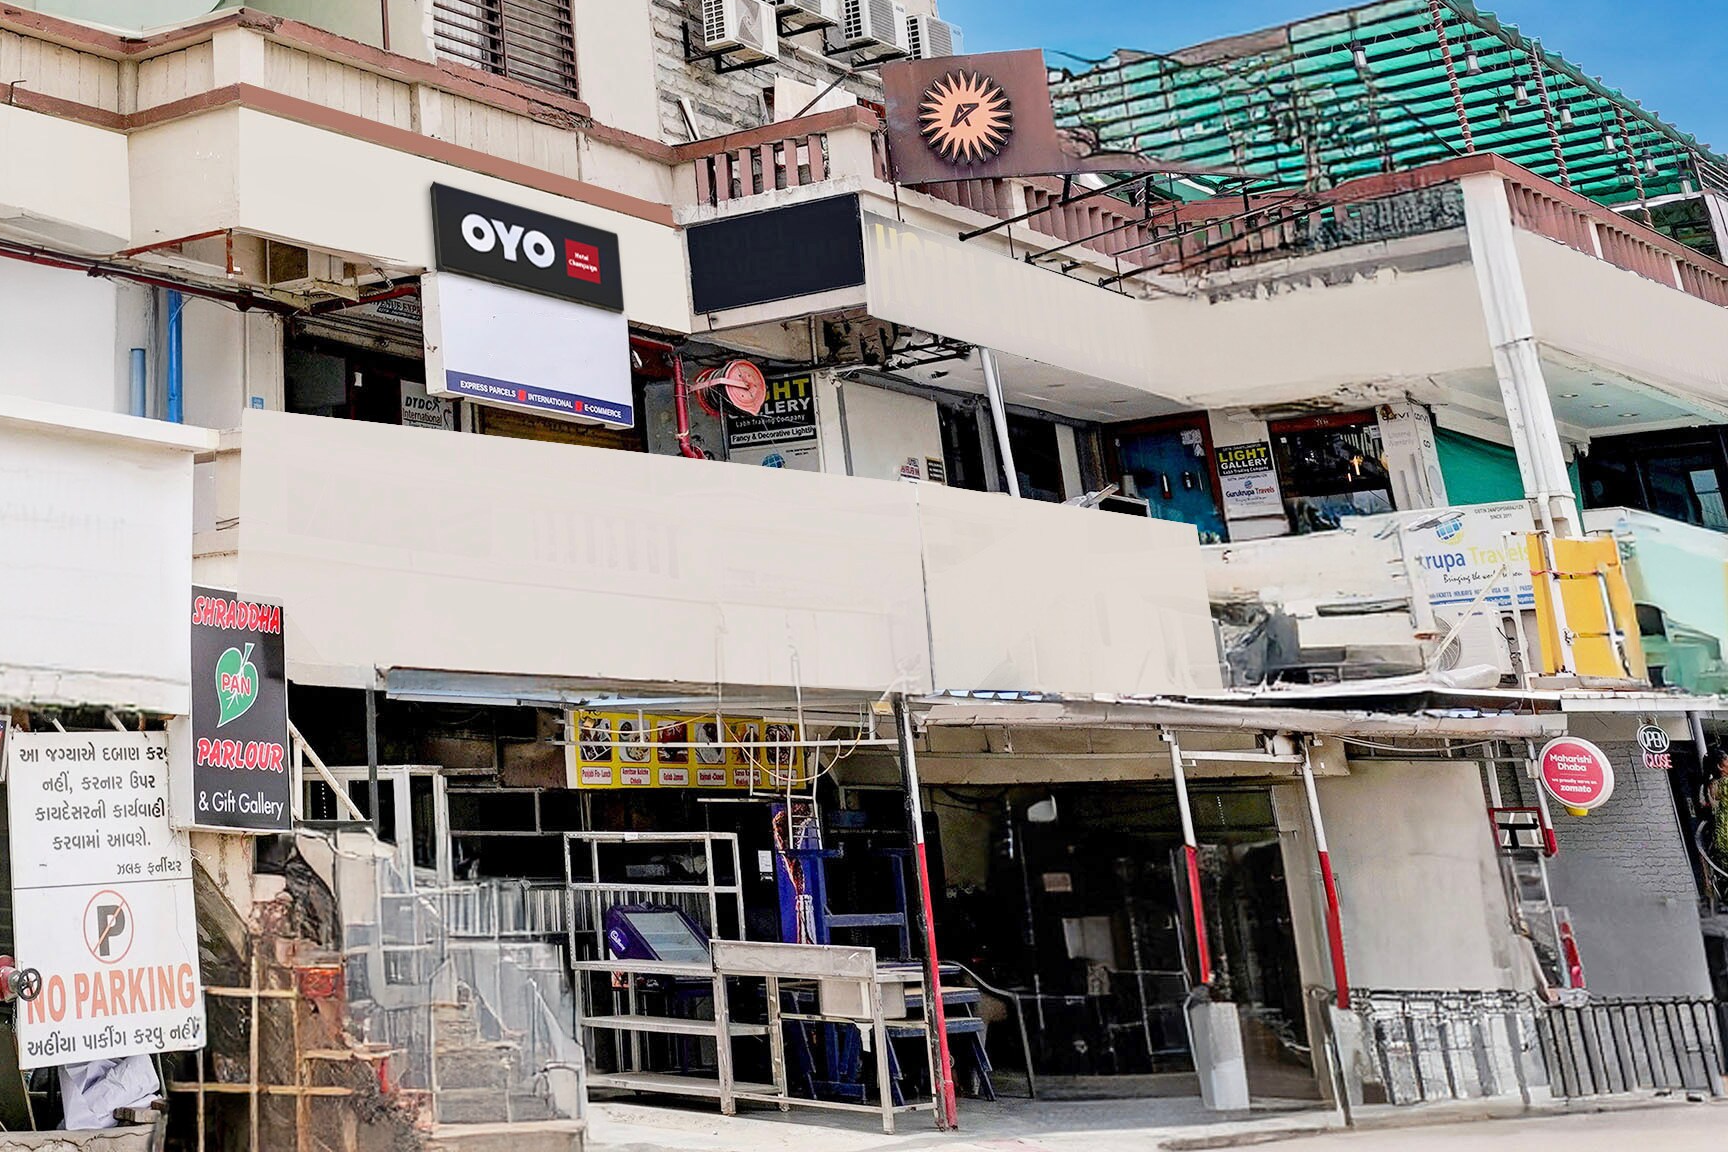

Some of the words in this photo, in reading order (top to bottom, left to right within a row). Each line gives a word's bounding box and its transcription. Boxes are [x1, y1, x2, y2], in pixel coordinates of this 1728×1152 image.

[461, 213, 556, 269] OYO
[574, 251, 589, 262] Hotel
[460, 380, 488, 393] EXPRESS
[488, 385, 516, 398] PARCELS
[527, 393, 573, 409] INTERNATIONAL
[584, 403, 622, 419] E-COMMERCE
[775, 414, 805, 424] Company
[732, 434, 750, 443] Fancy
[758, 429, 790, 440] Decorative
[1219, 447, 1266, 462] LIGHT
[1221, 457, 1268, 470] GALLERY
[192, 595, 282, 635] SHRADDHA
[220, 672, 251, 696] PAN
[1642, 729, 1667, 749] OPEN
[19, 748, 39, 763] આ
[45, 742, 96, 763] જગ્યાએ
[102, 747, 140, 762] દબાણ
[197, 736, 284, 774] PARLOUR
[1550, 753, 1592, 764] Maharishi
[1645, 752, 1673, 769] CLOSE
[1557, 762, 1587, 772] Dhaba
[81, 775, 123, 791] કરનાર
[130, 770, 156, 790] ઉપર
[1560, 784, 1592, 794] zomato
[35, 799, 106, 822] કાયદેસરની
[113, 796, 166, 819] કાર્યવાહી
[198, 790, 210, 812] &
[212, 789, 237, 814] Gift
[238, 791, 284, 821] Gallery
[52, 829, 101, 851] કરવામાં
[27, 974, 67, 1025] NO
[74, 963, 195, 1020] PARKING
